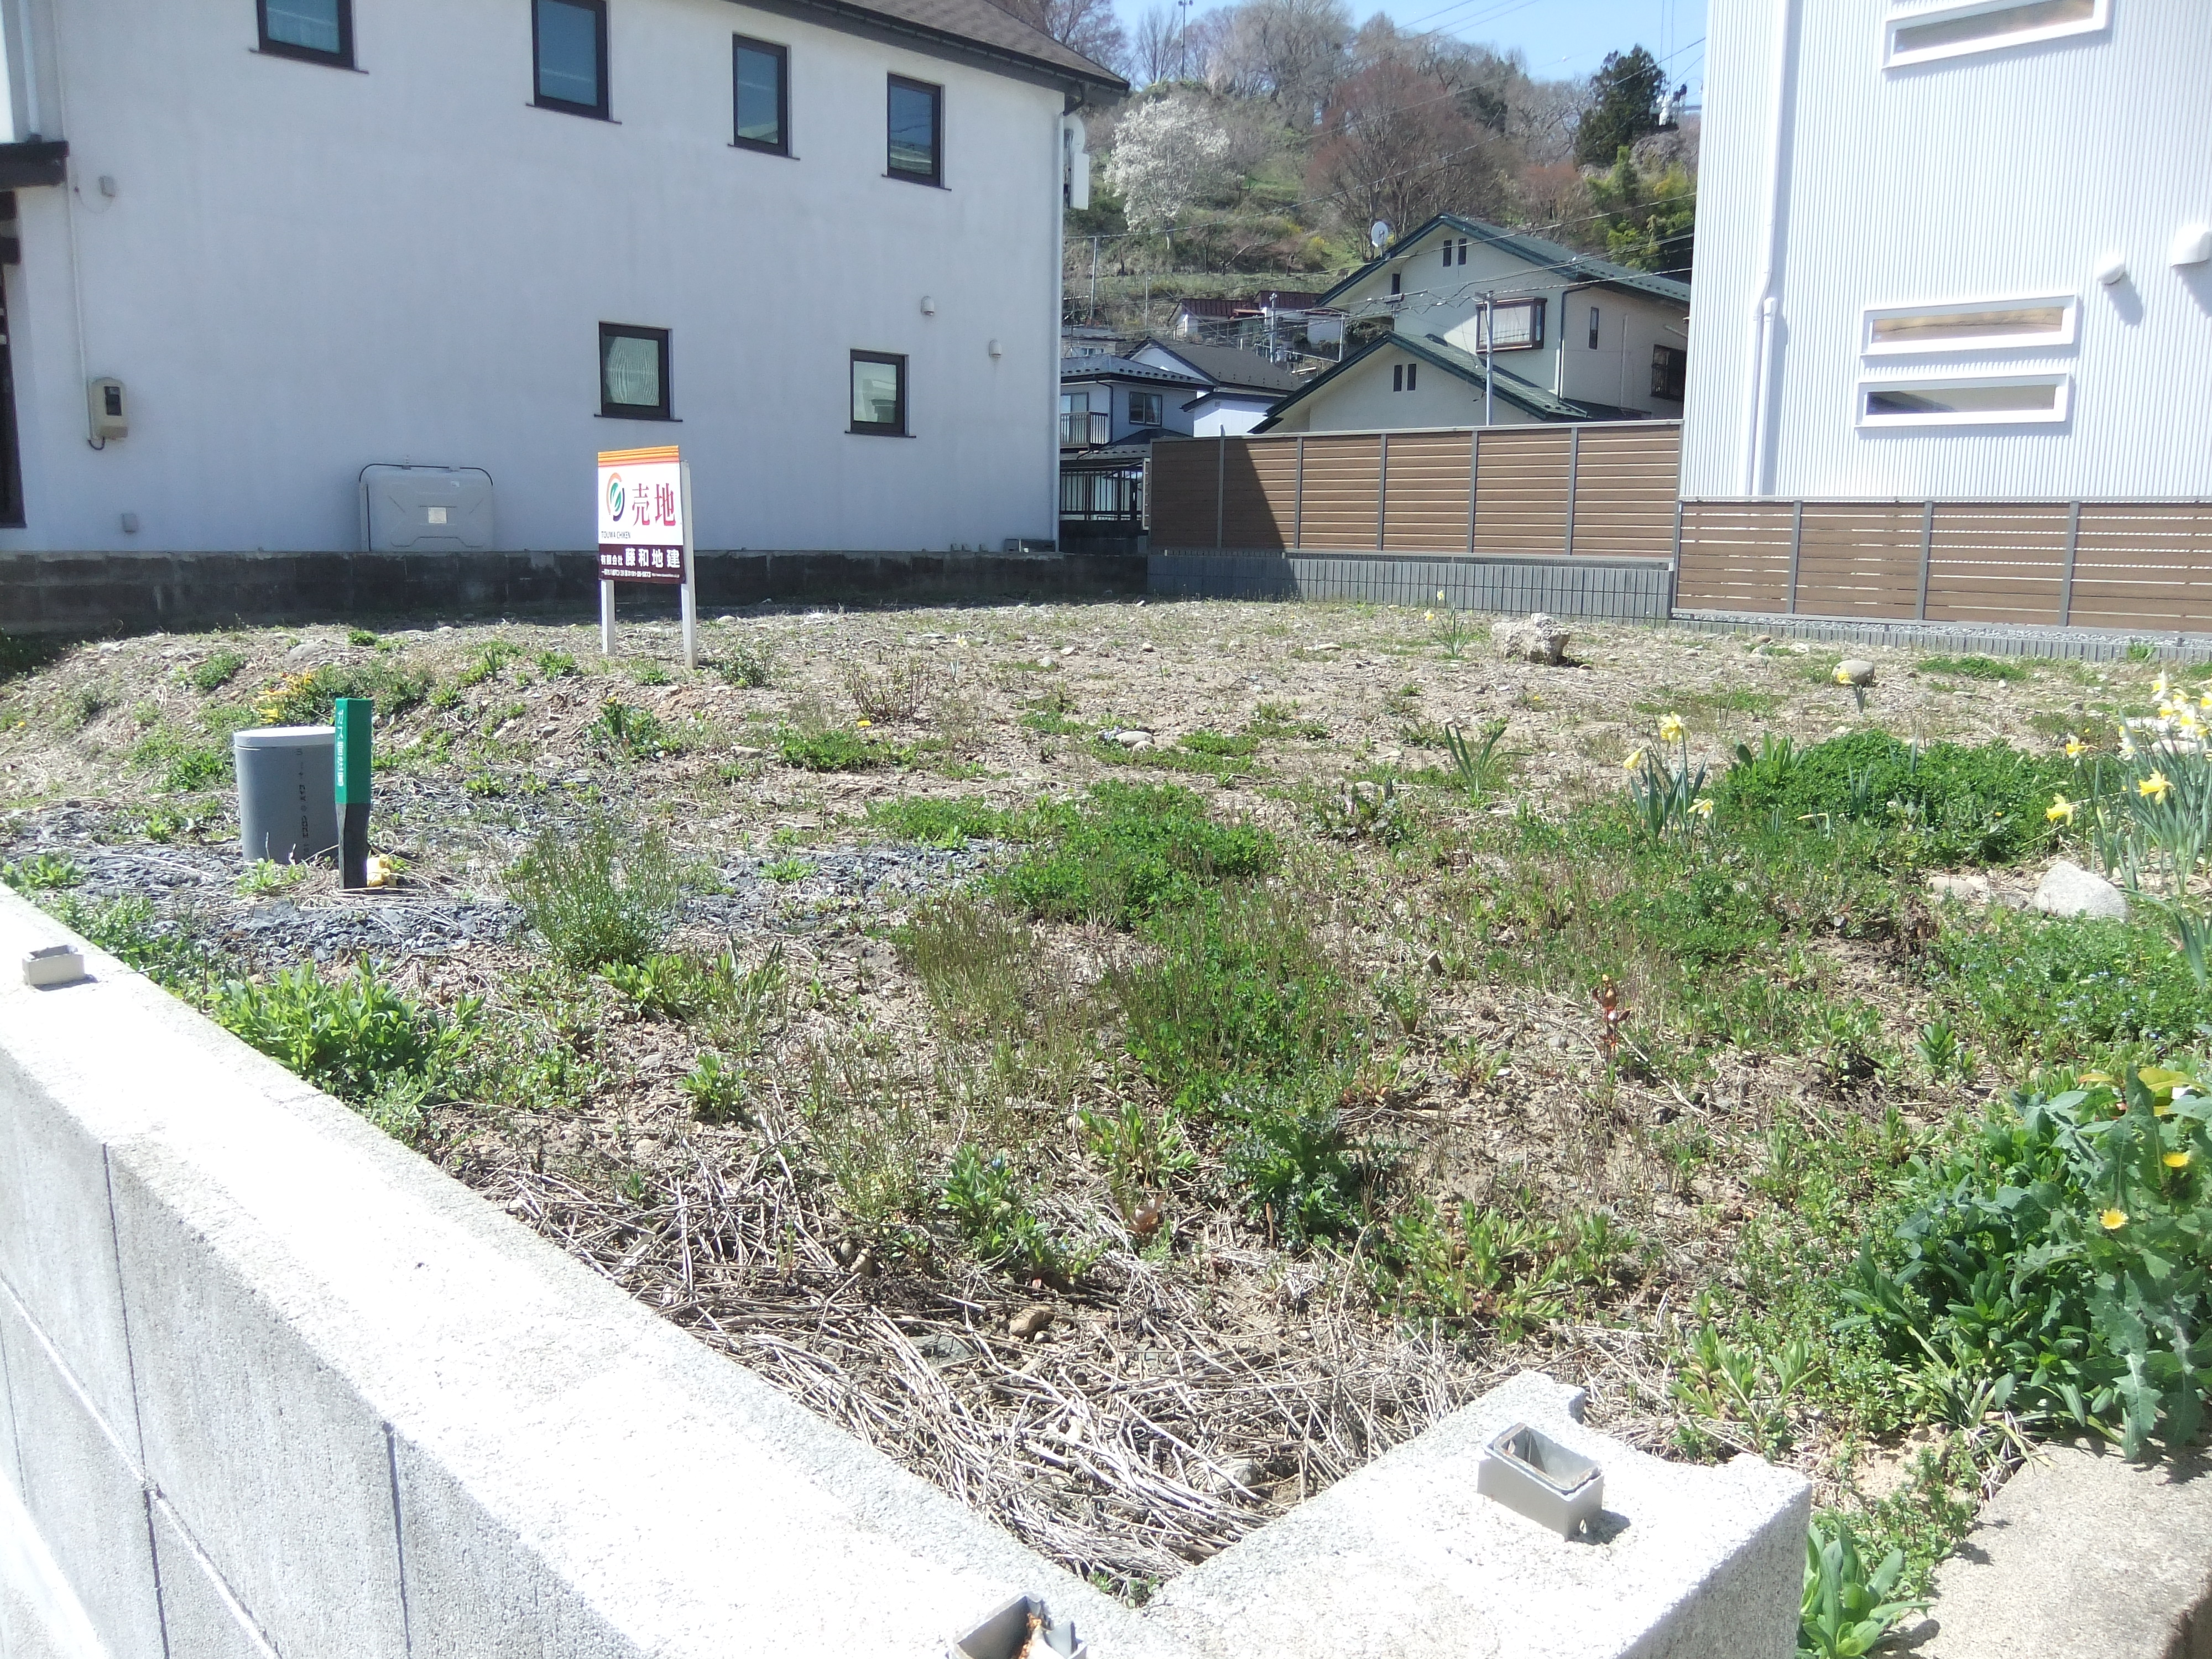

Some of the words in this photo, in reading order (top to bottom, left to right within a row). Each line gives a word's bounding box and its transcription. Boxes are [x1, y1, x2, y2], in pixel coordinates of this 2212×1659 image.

[632, 483, 676, 526] 売地
[601, 554, 623, 566] 有限会社
